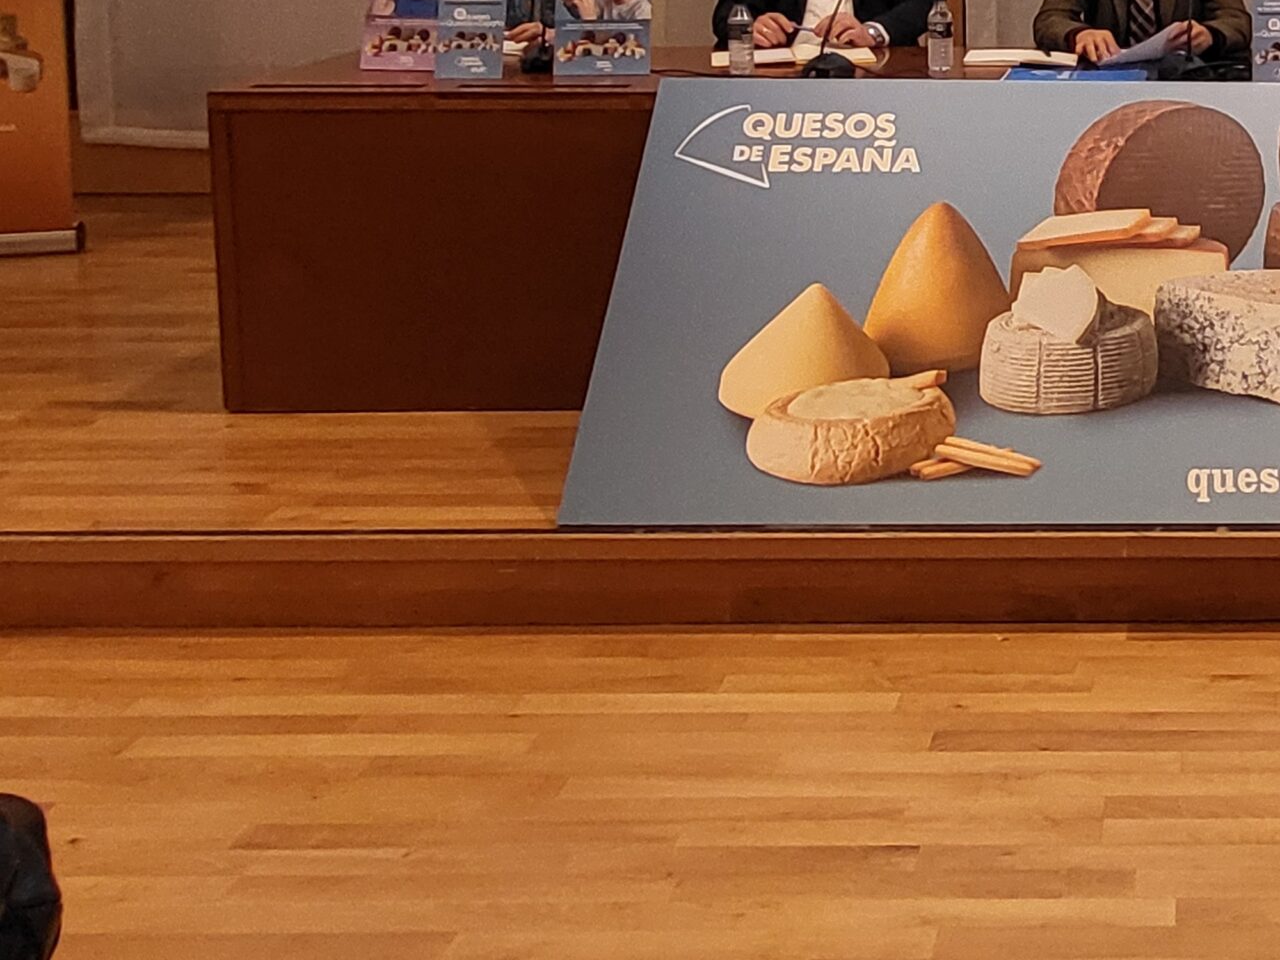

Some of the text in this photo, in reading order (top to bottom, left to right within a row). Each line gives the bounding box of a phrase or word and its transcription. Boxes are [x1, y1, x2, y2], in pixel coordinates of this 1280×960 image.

[742, 112, 897, 141] QUESOS
[732, 140, 921, 173] DE ESPAÑA
